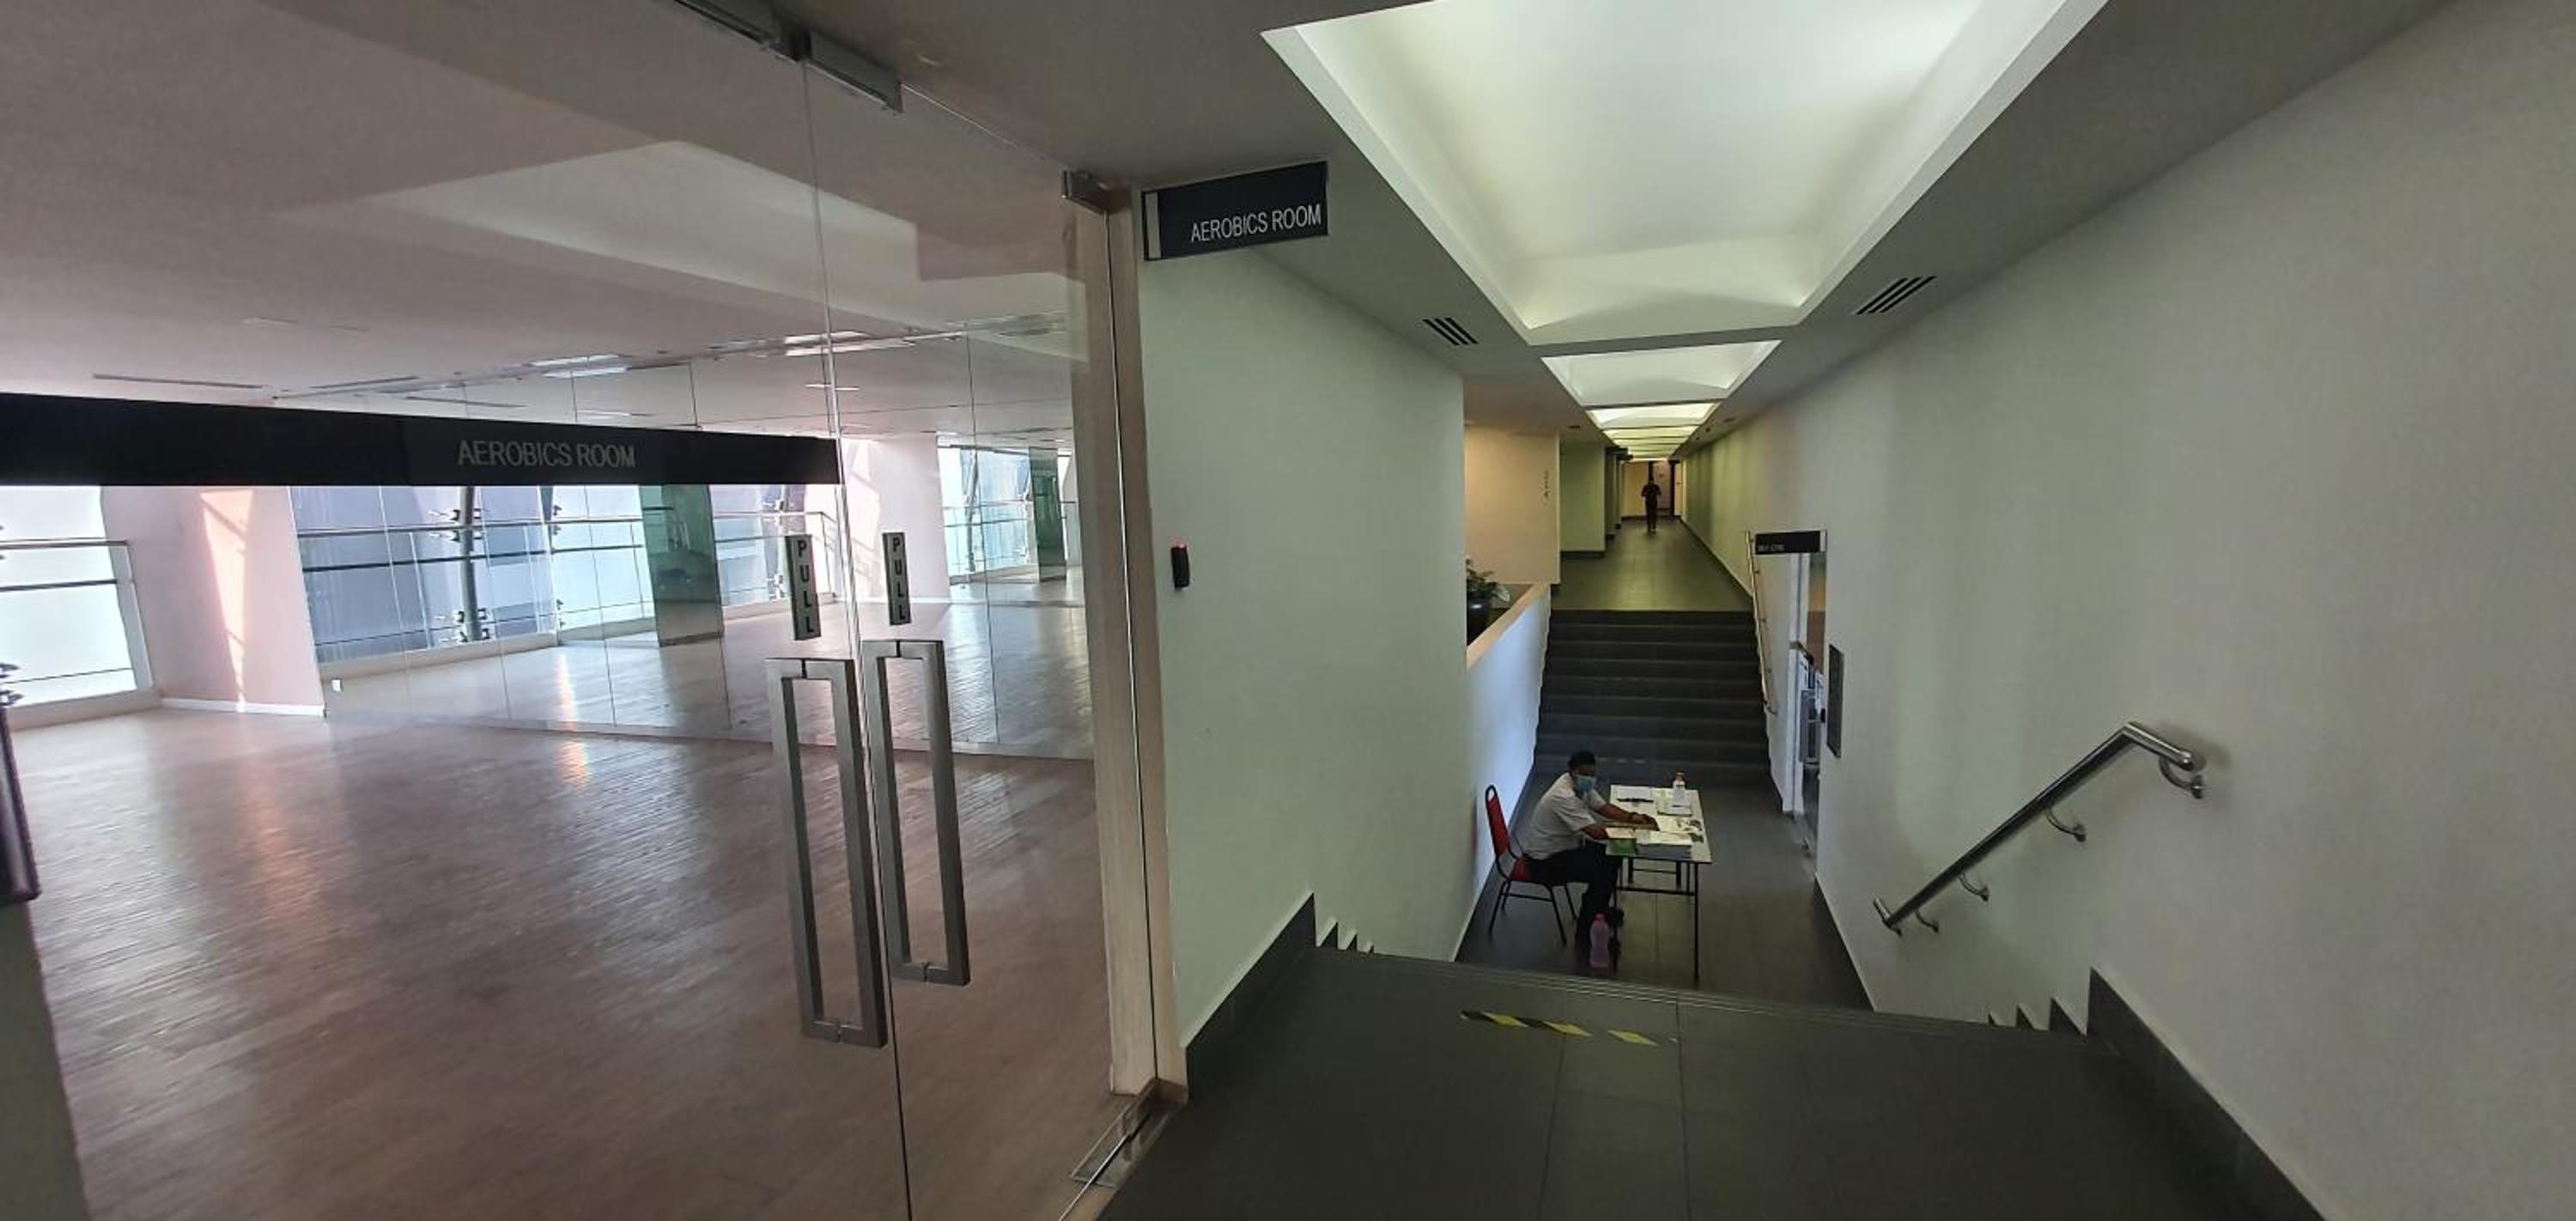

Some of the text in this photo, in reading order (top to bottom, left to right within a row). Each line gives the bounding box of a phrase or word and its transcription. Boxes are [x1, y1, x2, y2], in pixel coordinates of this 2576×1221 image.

[1190, 203, 1321, 243] AEROBICS ROOM
[459, 439, 636, 467] AEROBICS ROOM
[798, 540, 814, 633] PULL
[892, 537, 906, 620] PULL
